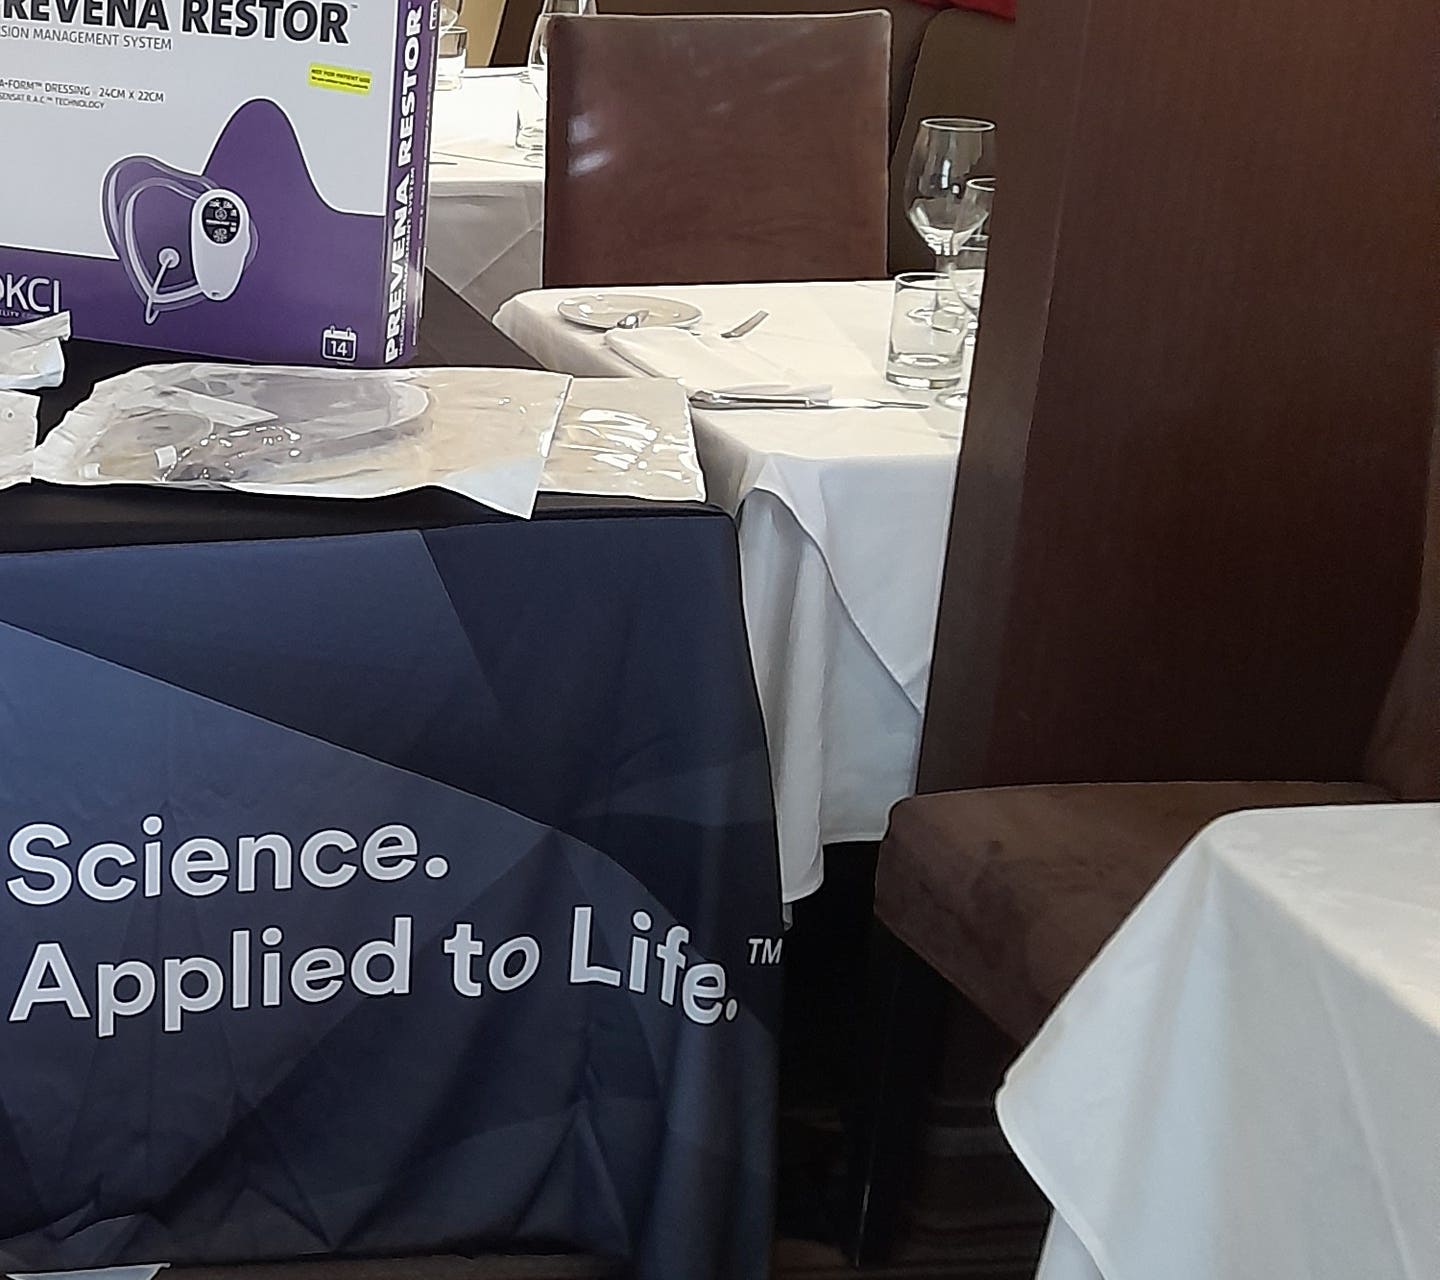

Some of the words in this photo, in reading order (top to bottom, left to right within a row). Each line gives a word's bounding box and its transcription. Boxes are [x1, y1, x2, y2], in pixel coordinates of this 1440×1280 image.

[33, 28, 120, 47] MANAGEMENT
[122, 34, 172, 50] SYSTEM
[44, 82, 91, 96] DRESSING
[137, 90, 164, 102] 22CM
[397, 5, 423, 168] RESTOR
[6, 273, 60, 313] KCI
[385, 173, 410, 364] PREVENA
[330, 340, 348, 357] 14
[6, 815, 449, 905] Science.
[8, 916, 413, 1038] Applied
[443, 923, 540, 997] to
